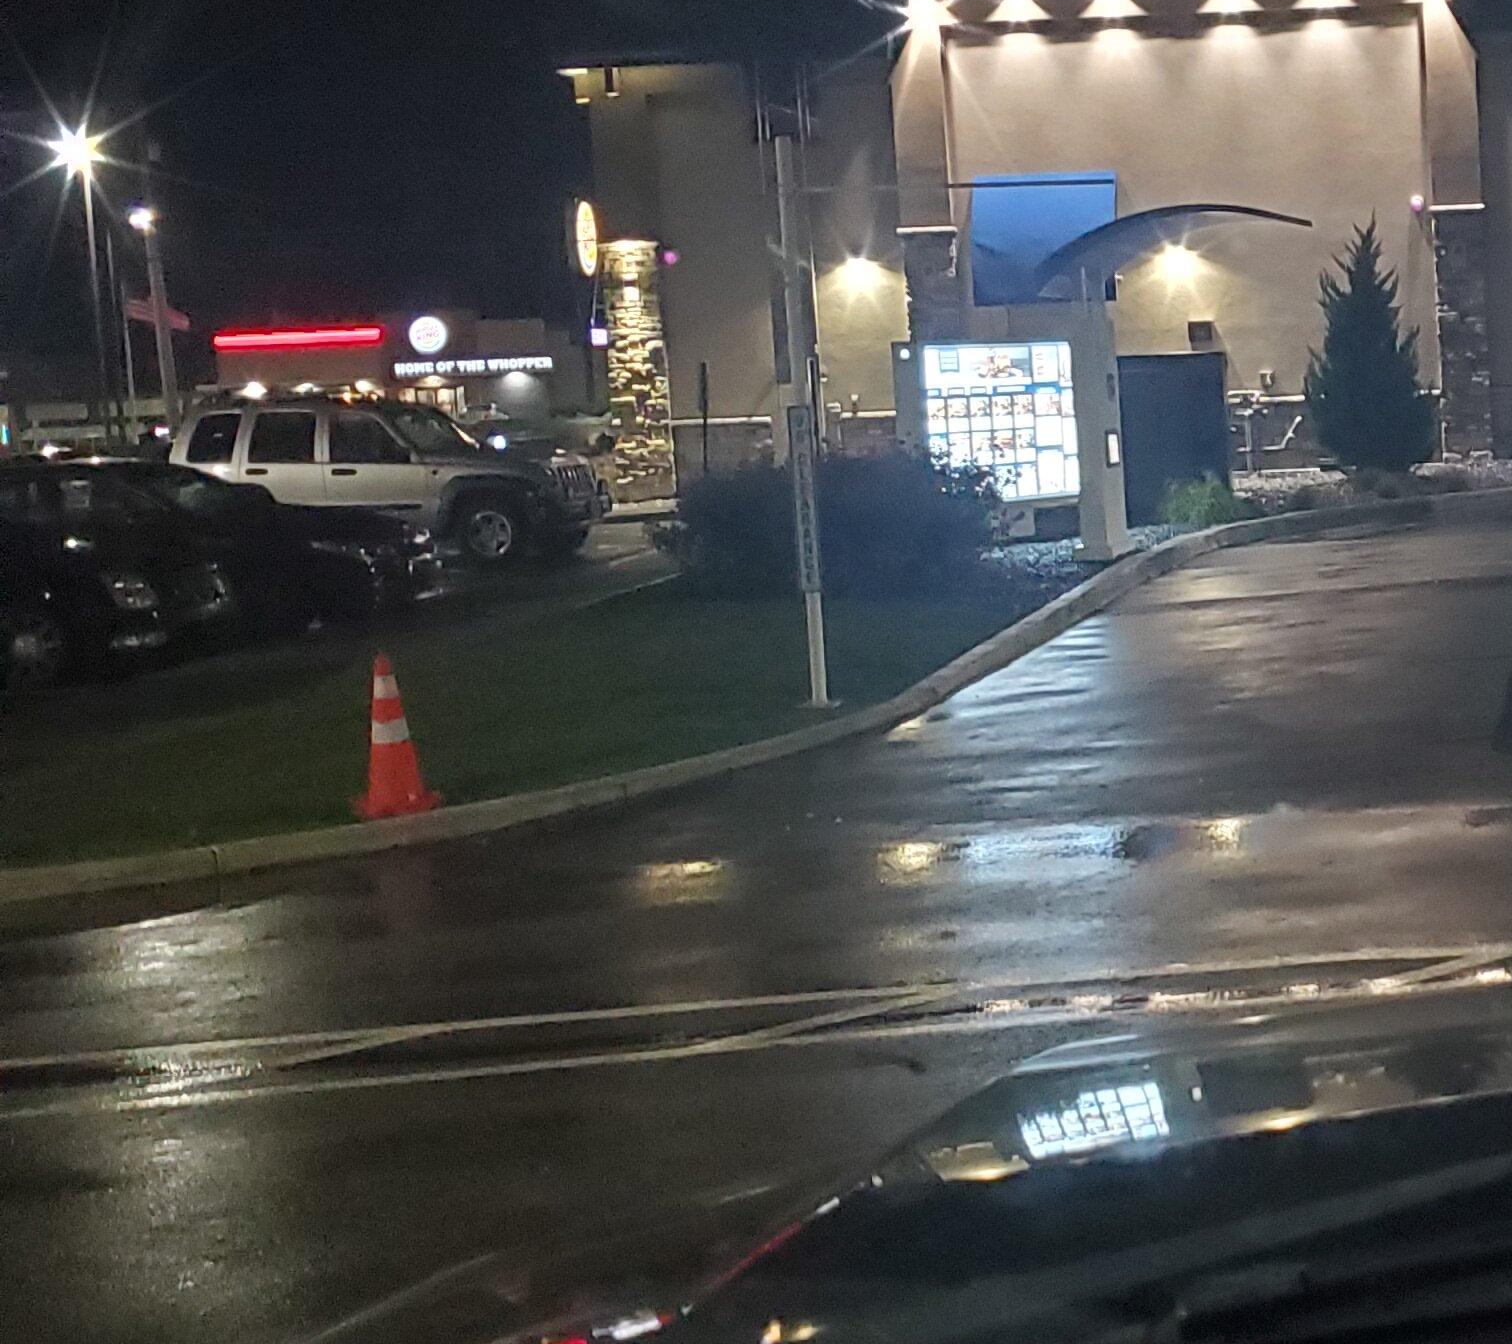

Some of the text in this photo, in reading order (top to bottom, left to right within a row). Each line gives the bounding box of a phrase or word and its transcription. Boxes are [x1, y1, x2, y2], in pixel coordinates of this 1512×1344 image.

[394, 356, 553, 375] HOME OF THE WHOPPER
